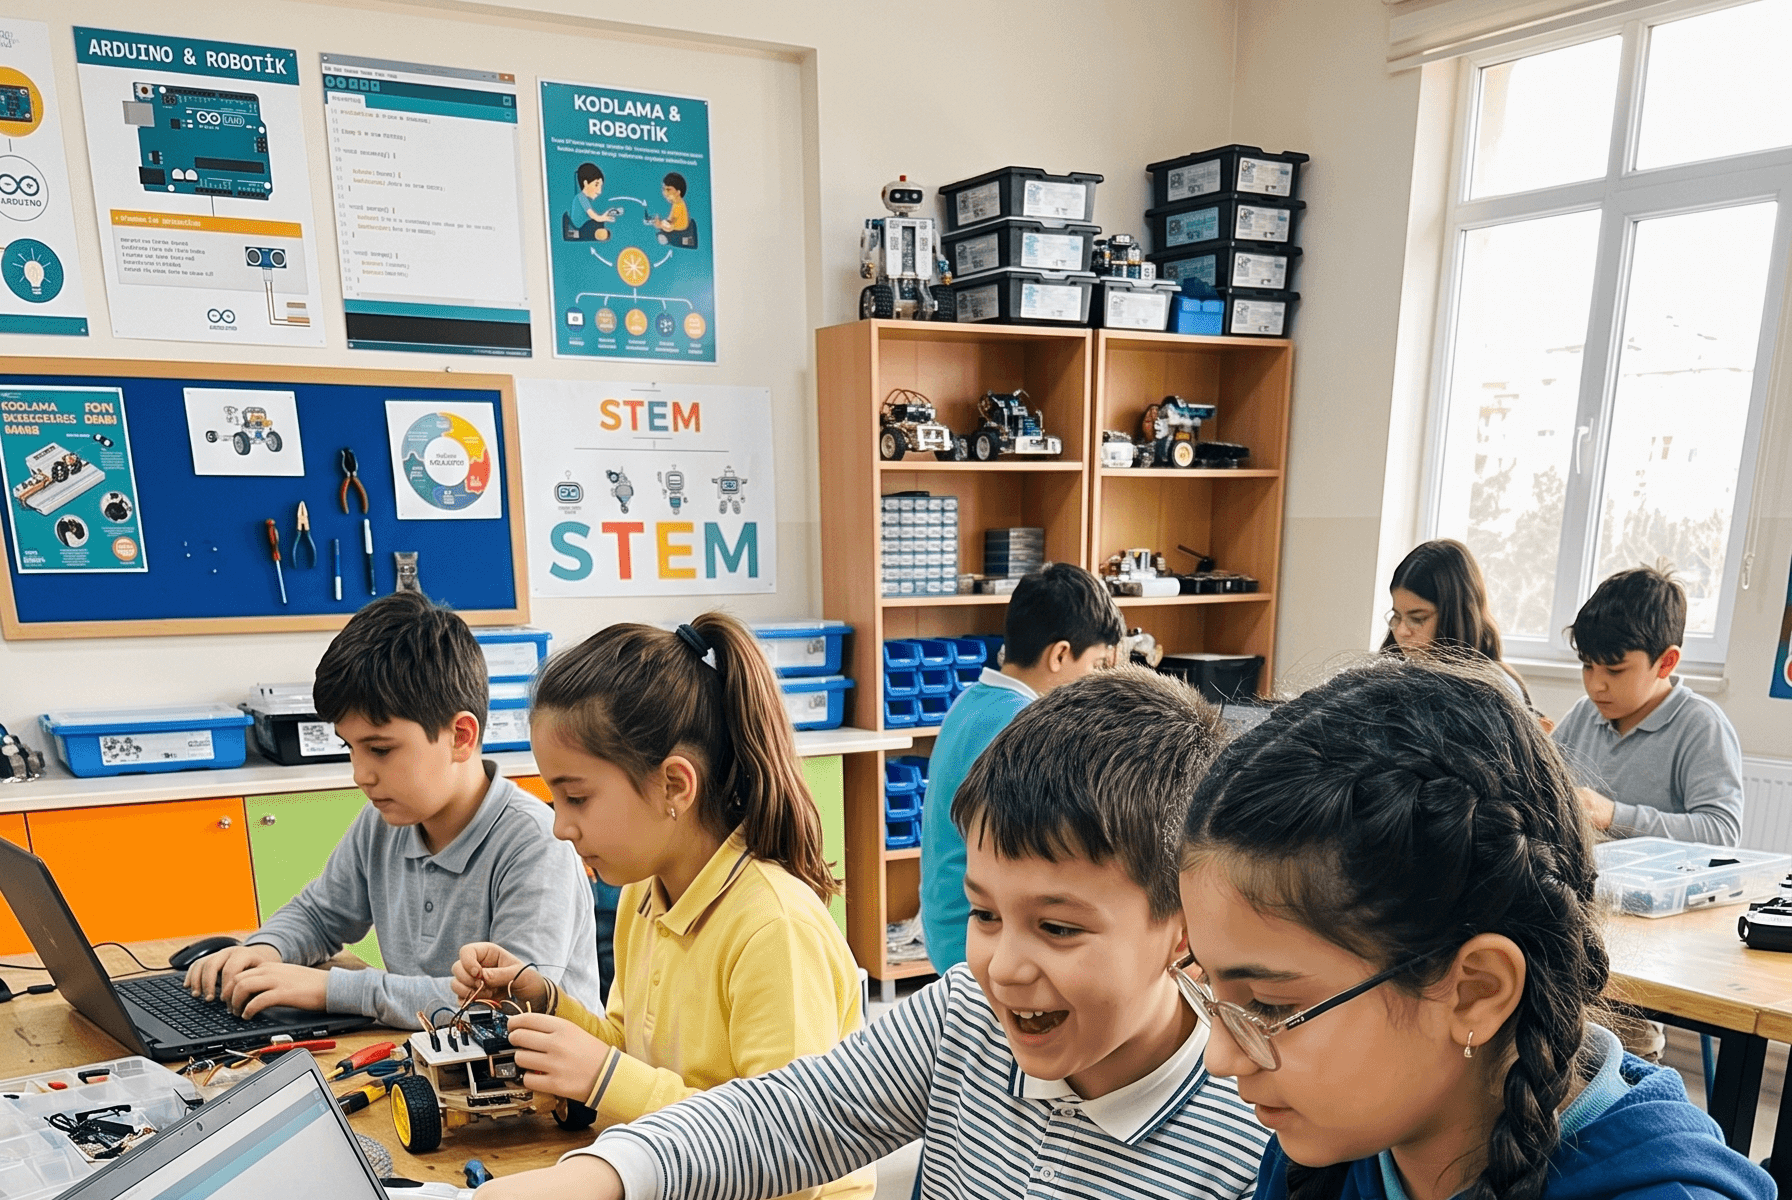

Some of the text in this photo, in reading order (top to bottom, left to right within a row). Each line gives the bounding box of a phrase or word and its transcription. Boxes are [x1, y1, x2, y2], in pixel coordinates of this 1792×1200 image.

[89, 38, 287, 75] ARDUINO & ROBOTİK
[574, 94, 681, 122] KODLAMA &
[590, 120, 668, 142] ROBOTİK
[1, 198, 42, 207] ARDUINO
[600, 399, 700, 432] STEM
[549, 521, 758, 581] STEM
